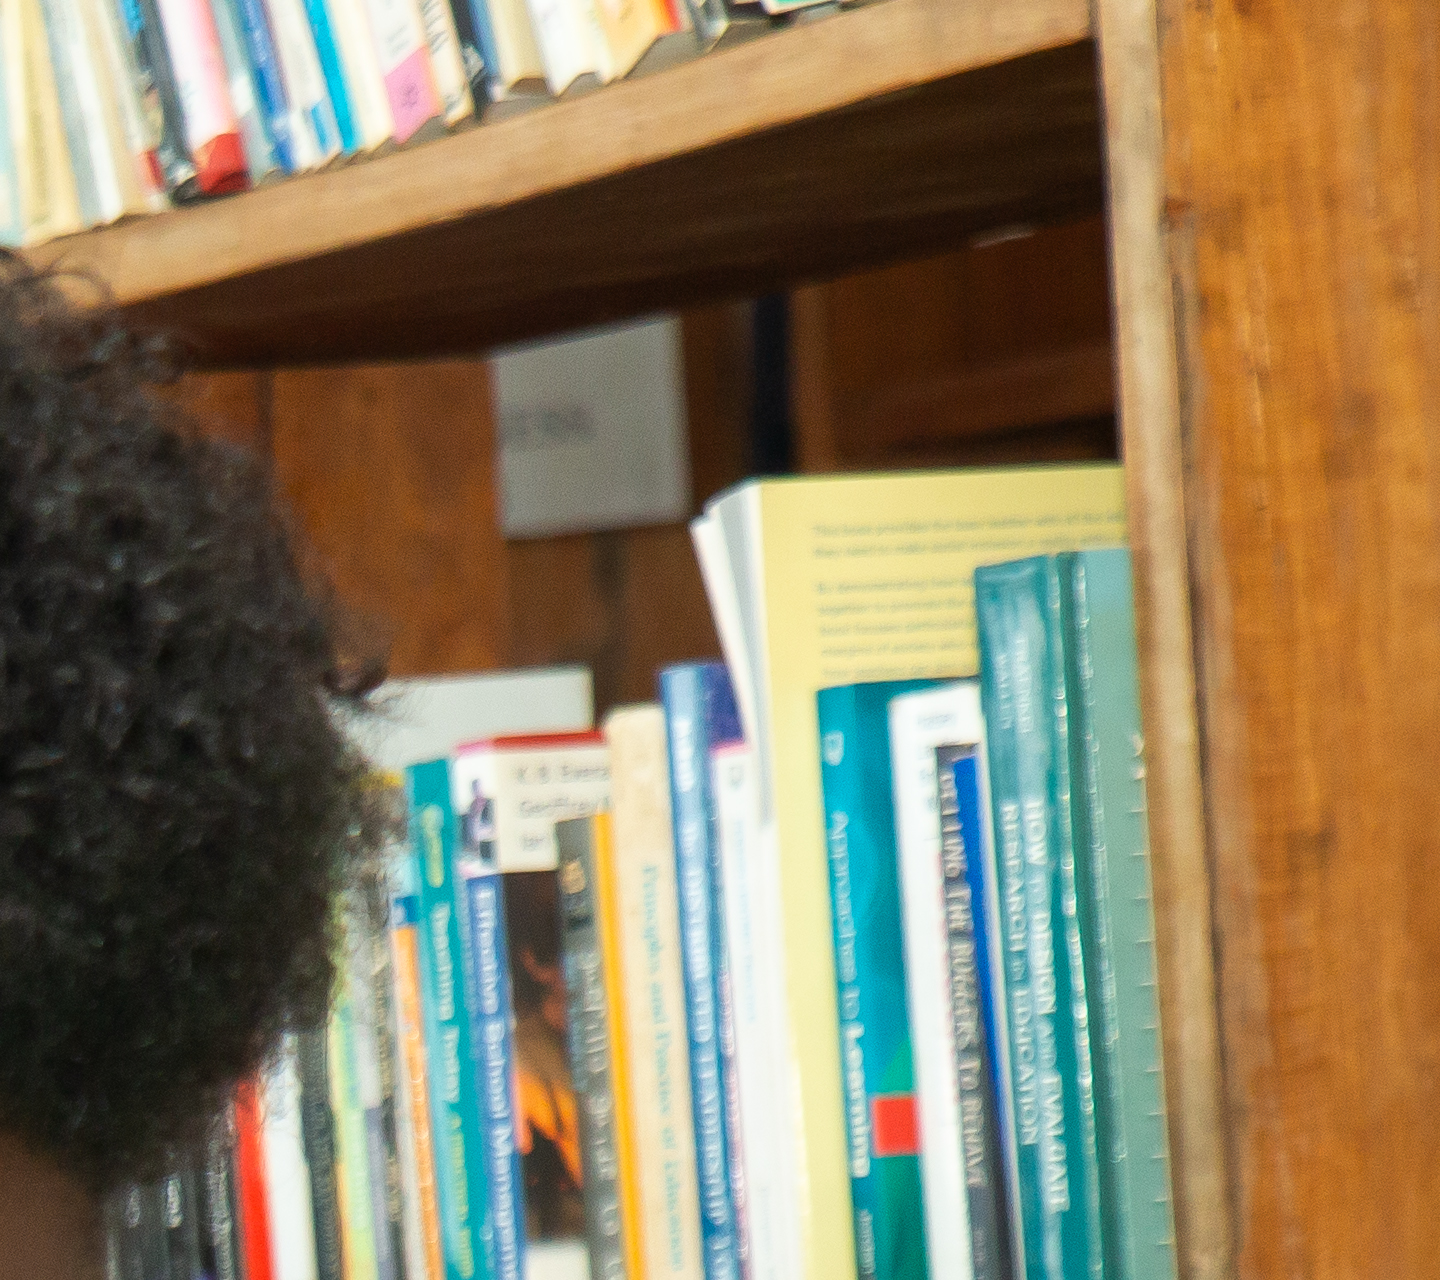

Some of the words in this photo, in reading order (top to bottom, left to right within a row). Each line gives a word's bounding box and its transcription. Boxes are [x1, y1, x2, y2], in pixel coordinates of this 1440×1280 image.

[999, 803, 1026, 952] RESEARCH
[1023, 799, 1047, 865] HOW
[477, 886, 503, 1015] Effective
[639, 864, 664, 975] Principles
[828, 810, 858, 983] Approaches
[430, 901, 456, 1021] Teaching
[842, 989, 863, 1019] to
[1032, 911, 1056, 1015] DESIGN
[440, 1024, 463, 1104] Today
[487, 1019, 514, 1120] School
[653, 1029, 676, 1119] Practice
[847, 1022, 868, 1178] Learning
[1010, 989, 1038, 1146] EDUCATION
[698, 1056, 726, 1227] LEADERSHIP
[1041, 1073, 1068, 1213] EVALUATE
[664, 1160, 686, 1271] Education
